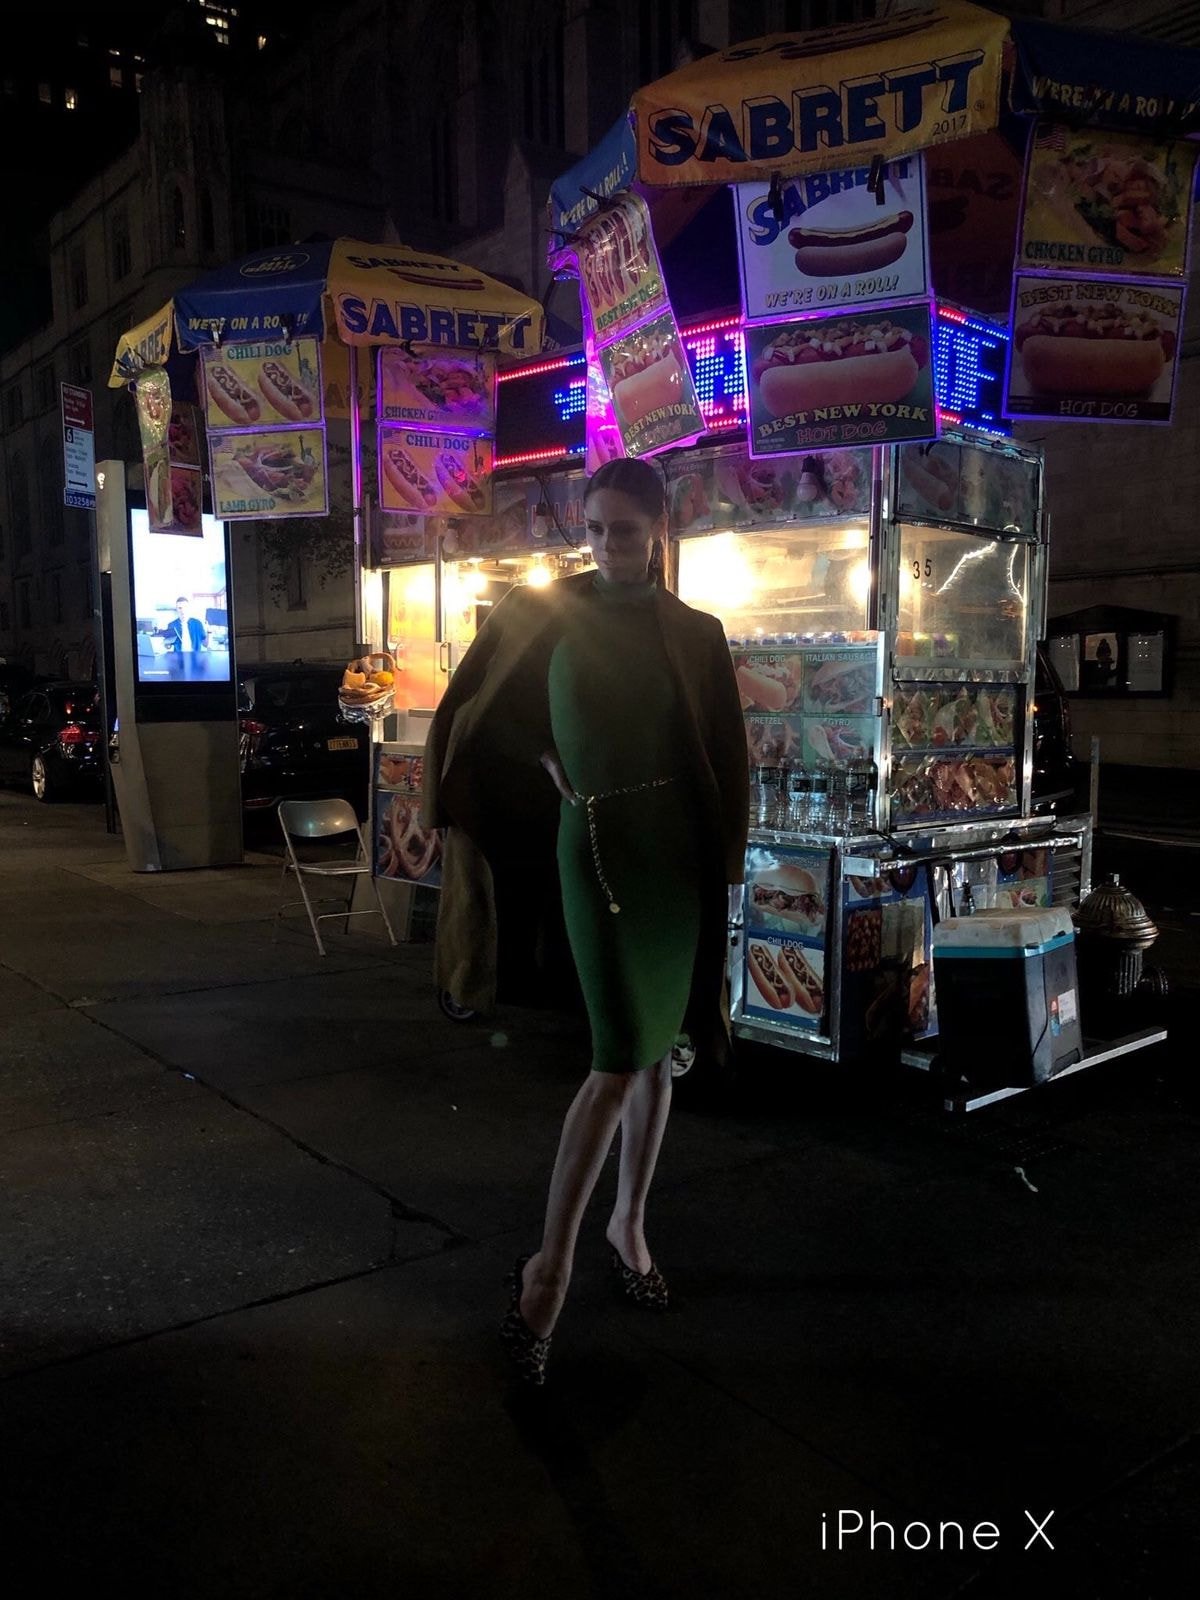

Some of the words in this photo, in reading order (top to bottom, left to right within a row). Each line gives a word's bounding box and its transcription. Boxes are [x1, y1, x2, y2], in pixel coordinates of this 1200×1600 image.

[648, 49, 984, 165] SABRETT
[932, 115, 967, 136] 2017
[1025, 242, 1083, 260] CHICKEN
[765, 287, 812, 308] WE'RE
[816, 284, 839, 301] ON
[841, 283, 852, 298] A
[854, 275, 900, 297] ROLL!
[1021, 285, 1072, 307] BEST
[1078, 284, 1123, 300] NEW
[1126, 289, 1178, 317] YORK
[231, 317, 248, 330] ON
[251, 316, 260, 329] A
[339, 293, 532, 349] SABRETT
[226, 345, 261, 360] CHILI
[264, 343, 293, 358] DOG
[385, 406, 426, 419] CHICKEN
[758, 411, 808, 438] BEST
[813, 403, 861, 420] NEW
[866, 402, 928, 421] YORK
[1059, 400, 1096, 416] HOT
[1100, 402, 1139, 418] DOG
[624, 419, 646, 441] BEST
[645, 409, 668, 426] NEW
[668, 403, 696, 417] YORK
[796, 424, 838, 444] HOT
[841, 420, 888, 440] DOG
[406, 434, 440, 449] CHILI
[444, 438, 470, 452] DOG
